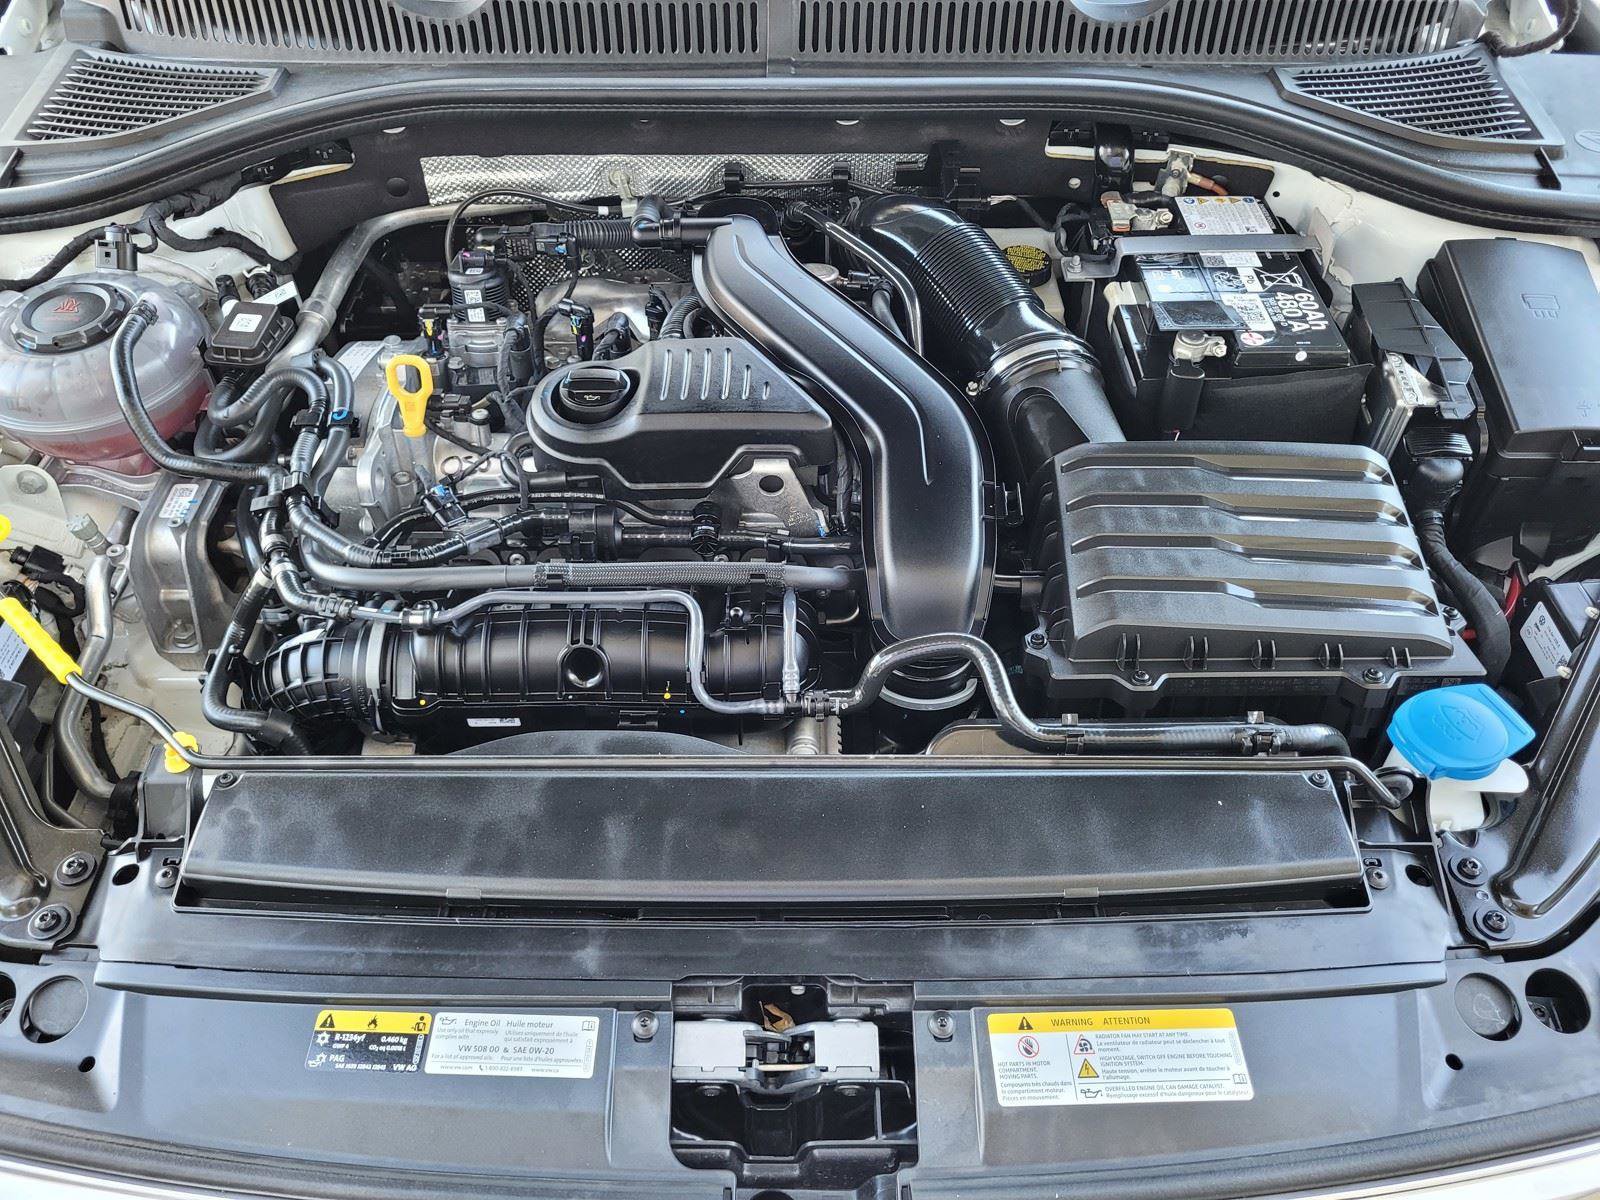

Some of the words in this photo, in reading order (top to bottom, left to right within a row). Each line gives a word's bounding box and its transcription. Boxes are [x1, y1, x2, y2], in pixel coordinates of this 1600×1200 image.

[1275, 292, 1303, 318] 480
[1294, 292, 1329, 330] 60Ah
[1287, 320, 1311, 332] A
[464, 1019, 489, 1028] Engine
[490, 1019, 501, 1027] Oil
[1051, 1018, 1094, 1027] WARNING
[1103, 1016, 1151, 1025] ATTENTION
[334, 1033, 367, 1044] R-1234yf
[400, 1037, 408, 1045] kg
[473, 1045, 488, 1053] 508
[329, 1054, 345, 1062] PAG
[393, 1063, 405, 1071] VW
[405, 1064, 418, 1072] AG
